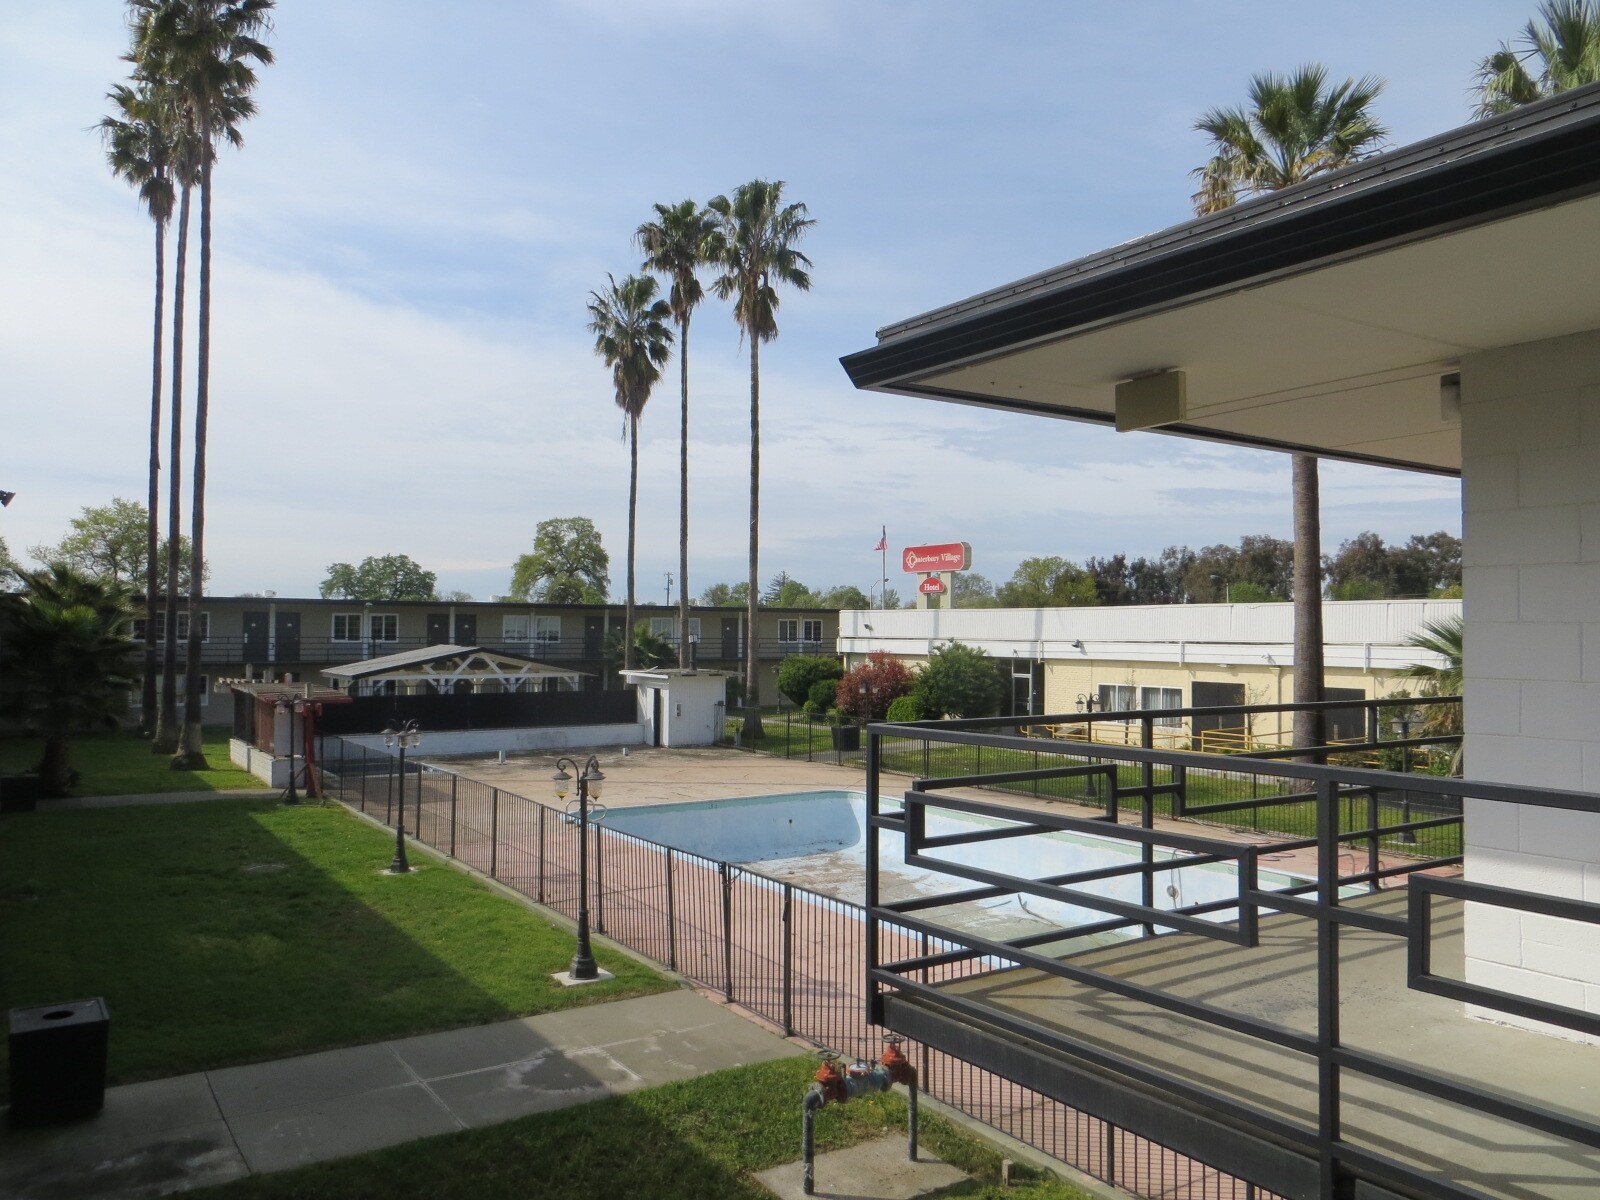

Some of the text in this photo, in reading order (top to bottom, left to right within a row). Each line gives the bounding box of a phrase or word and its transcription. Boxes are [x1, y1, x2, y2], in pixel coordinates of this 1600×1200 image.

[907, 553, 961, 566] Canterbury Village
[924, 583, 940, 591] Hotel
